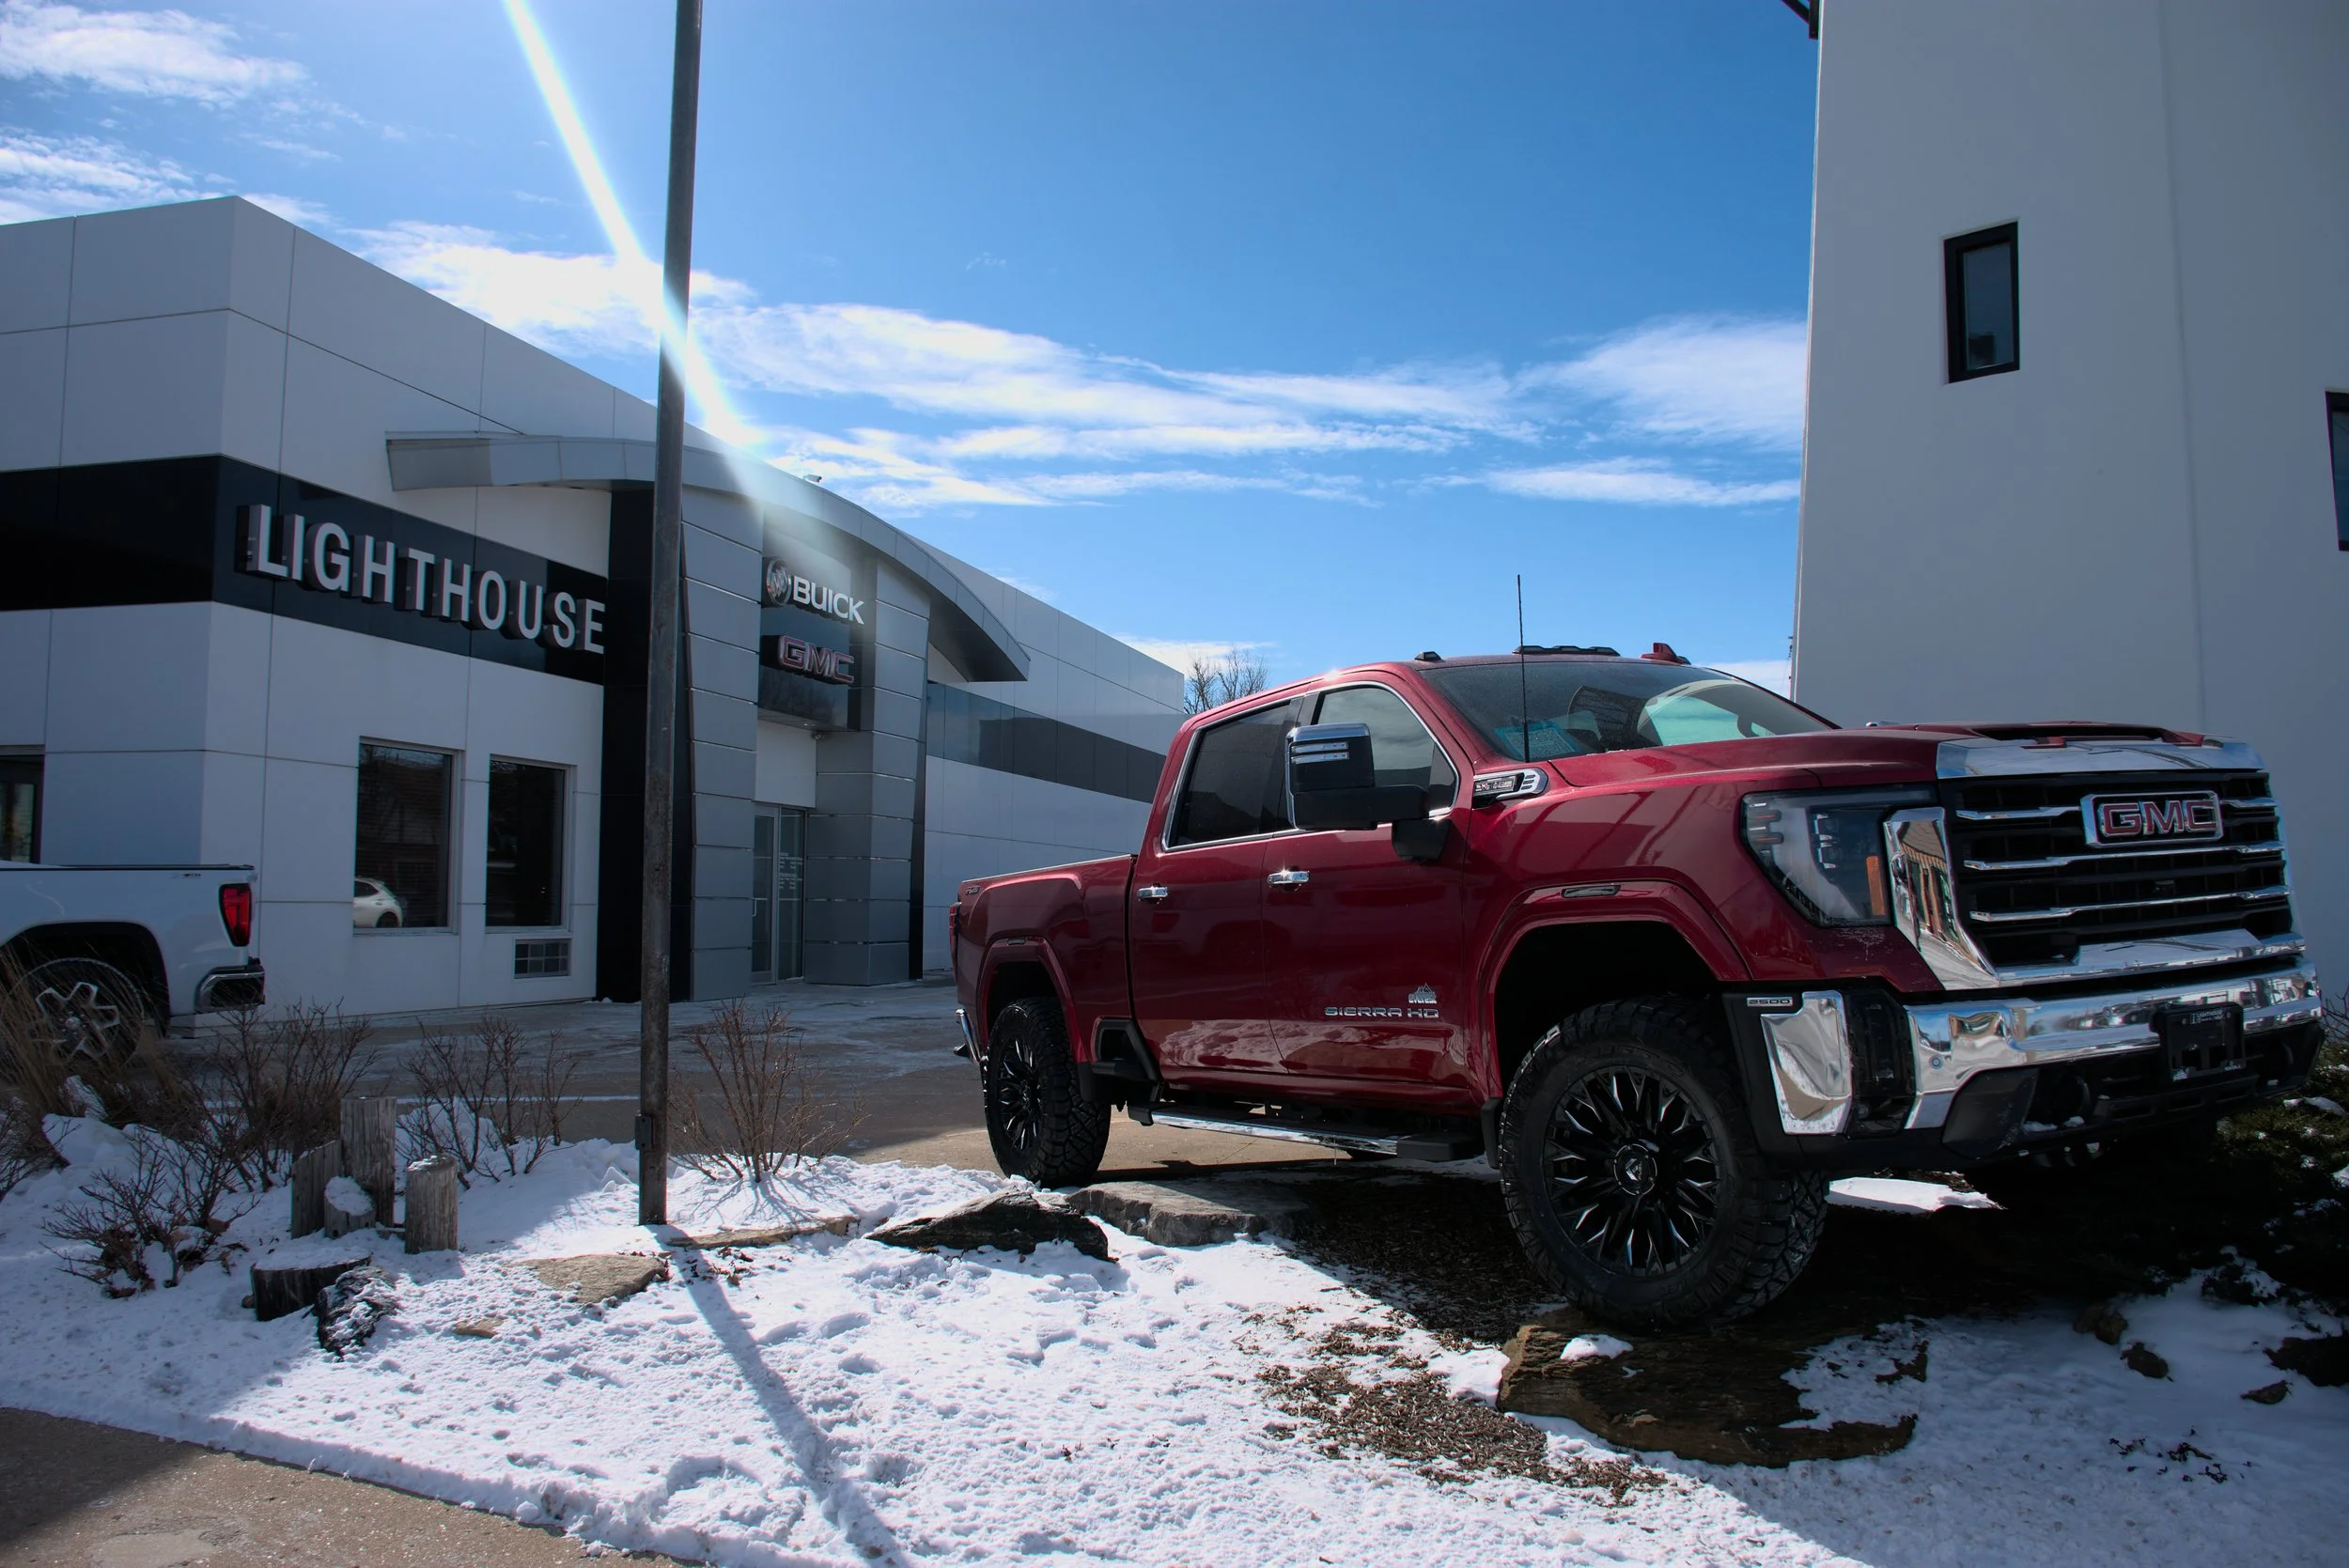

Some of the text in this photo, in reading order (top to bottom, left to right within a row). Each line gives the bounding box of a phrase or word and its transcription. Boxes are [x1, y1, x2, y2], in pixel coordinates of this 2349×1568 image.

[248, 505, 606, 654] LIGHTHOUSE
[793, 574, 864, 625] BUICK
[780, 635, 854, 684] GMC
[2098, 800, 2217, 837] GMC
[1325, 1006, 1439, 1018] SIERRA HD
